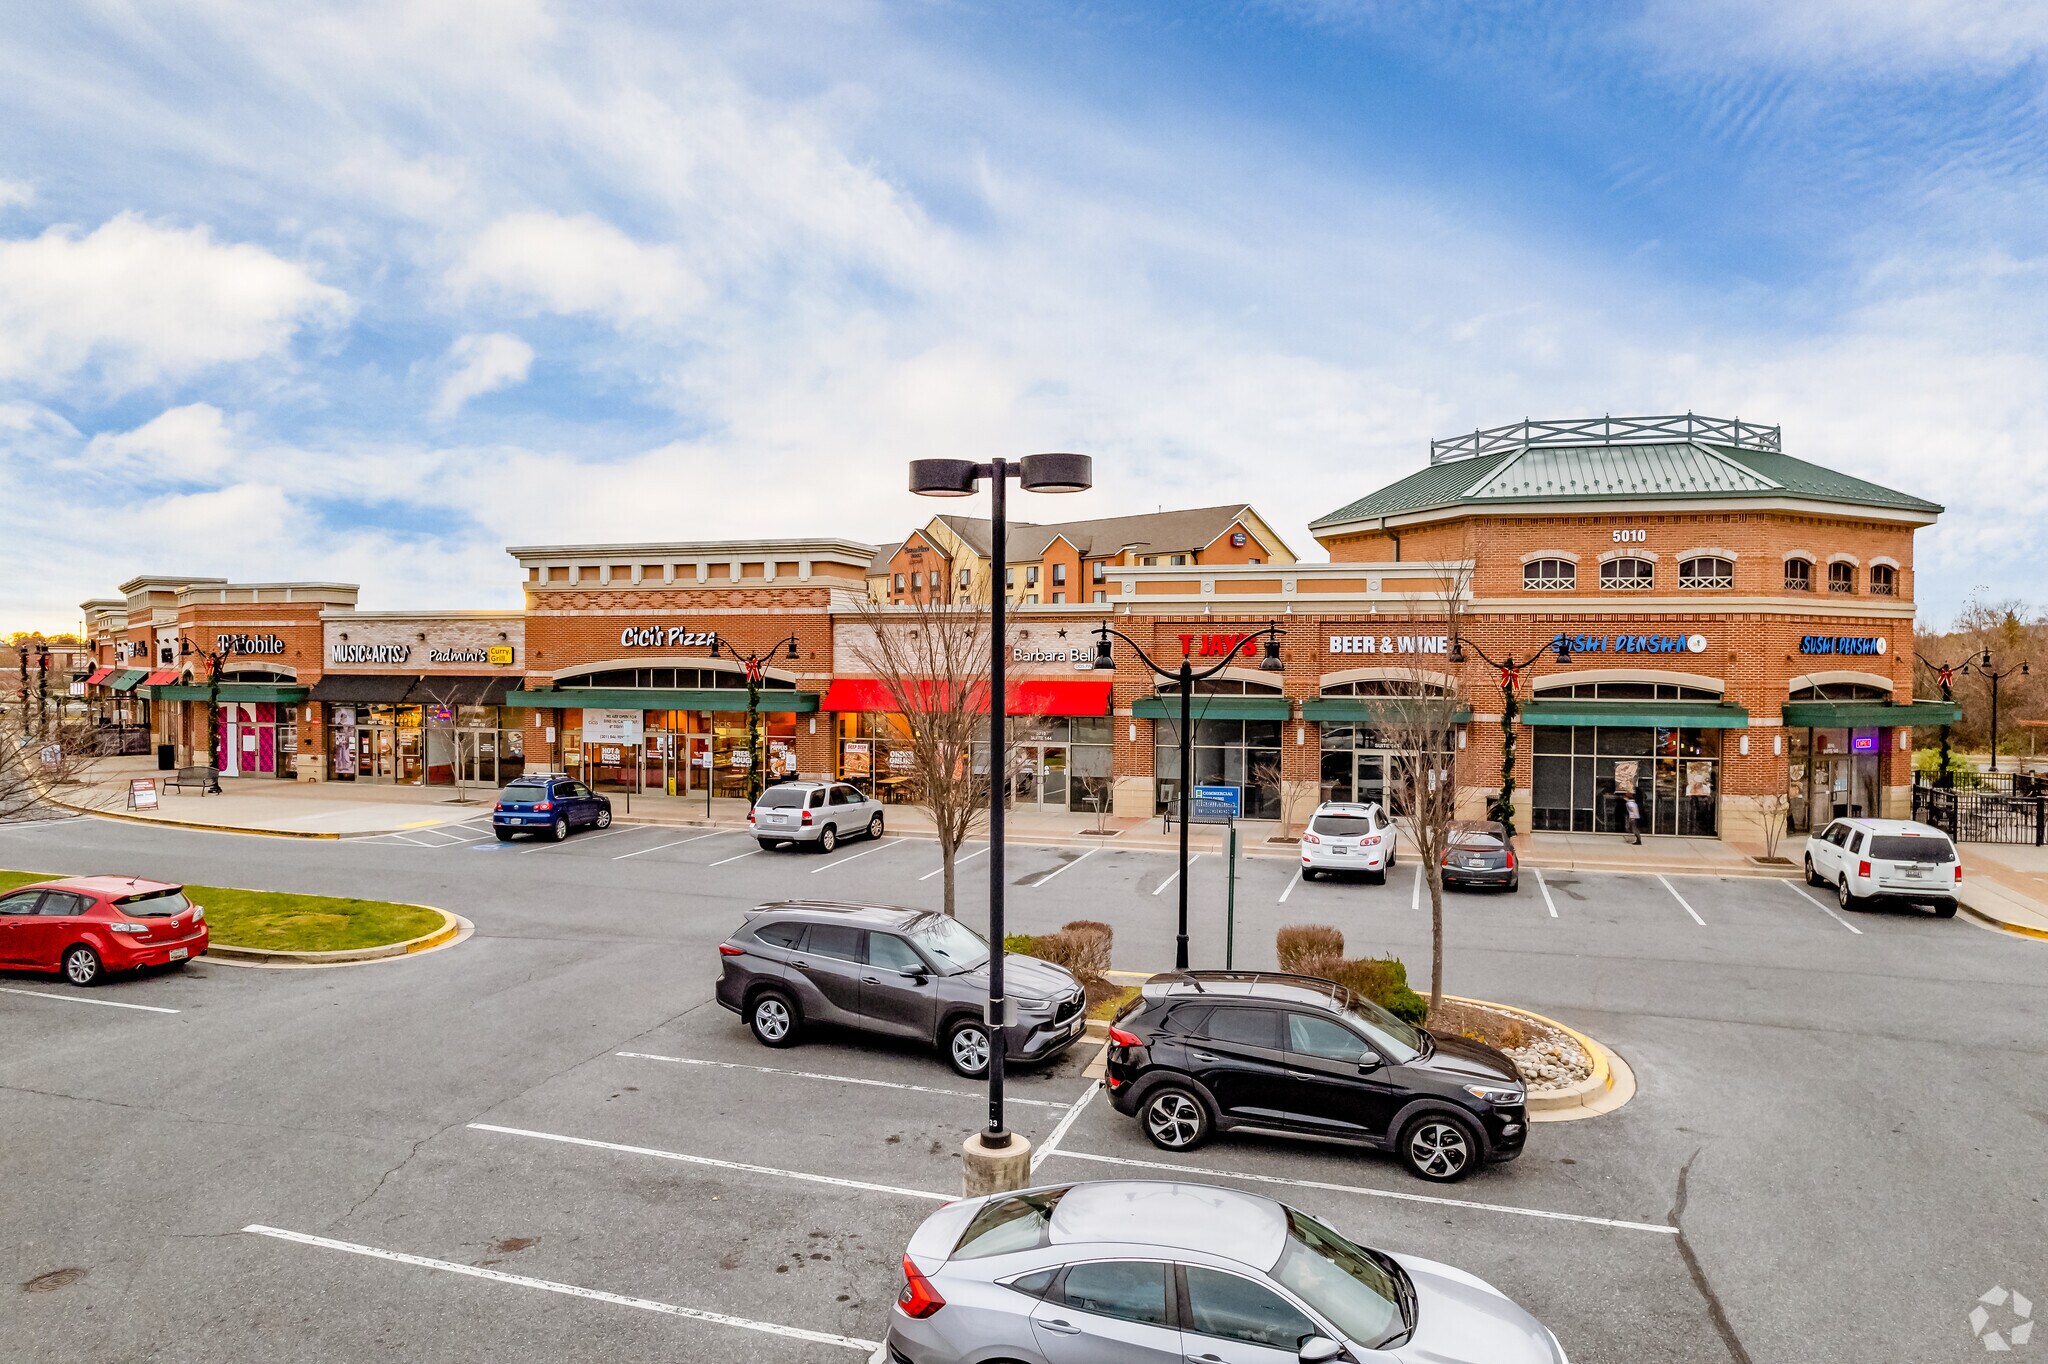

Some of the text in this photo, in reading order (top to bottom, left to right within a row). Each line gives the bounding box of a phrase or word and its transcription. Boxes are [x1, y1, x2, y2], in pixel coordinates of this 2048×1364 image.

[1612, 529, 1646, 543] 5010
[667, 626, 716, 647] Pizza
[1178, 633, 1258, 656] T JAY'S
[1329, 636, 1448, 654] BEER & WINE
[1614, 634, 1687, 654] DENSHA
[1803, 635, 1876, 655] SUSHI DENSHA
[429, 647, 486, 662] Padmini's
[1013, 647, 1094, 662] Barbara Bell
